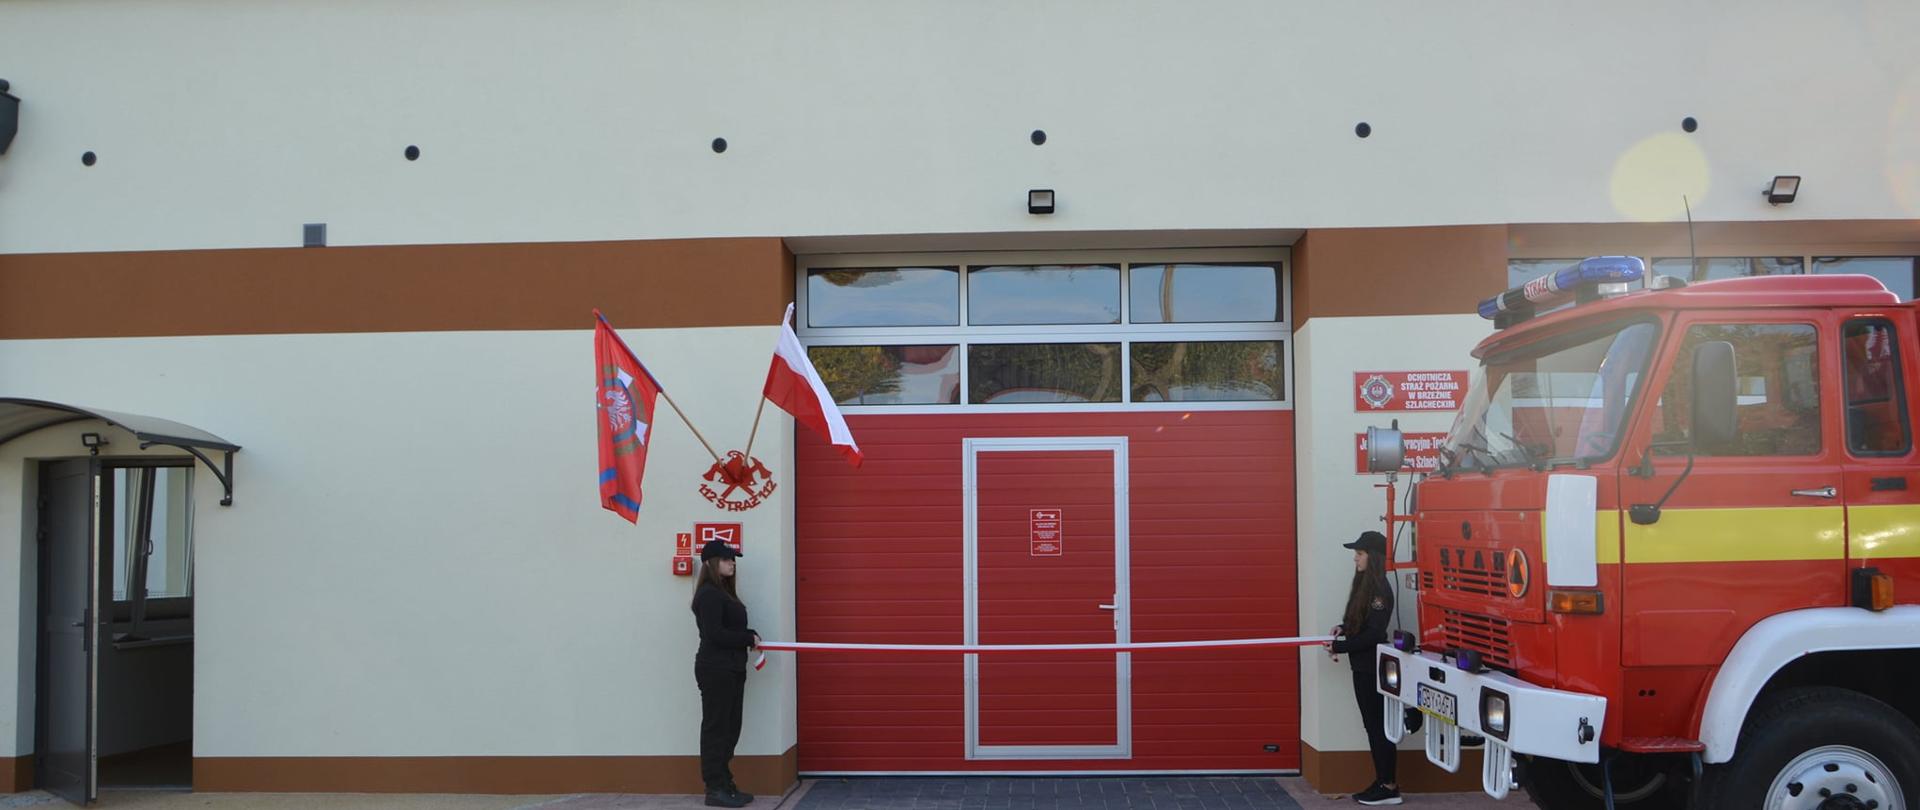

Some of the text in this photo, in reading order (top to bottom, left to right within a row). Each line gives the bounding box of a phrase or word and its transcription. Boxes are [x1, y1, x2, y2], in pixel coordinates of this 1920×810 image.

[1407, 373, 1451, 381] OCHOTNICZA
[1400, 381, 1459, 390] STRAŻ POŻARNA
[1408, 392, 1416, 400] W
[1405, 400, 1456, 409] SZLACHECKIM
[1440, 547, 1505, 571] STAR
